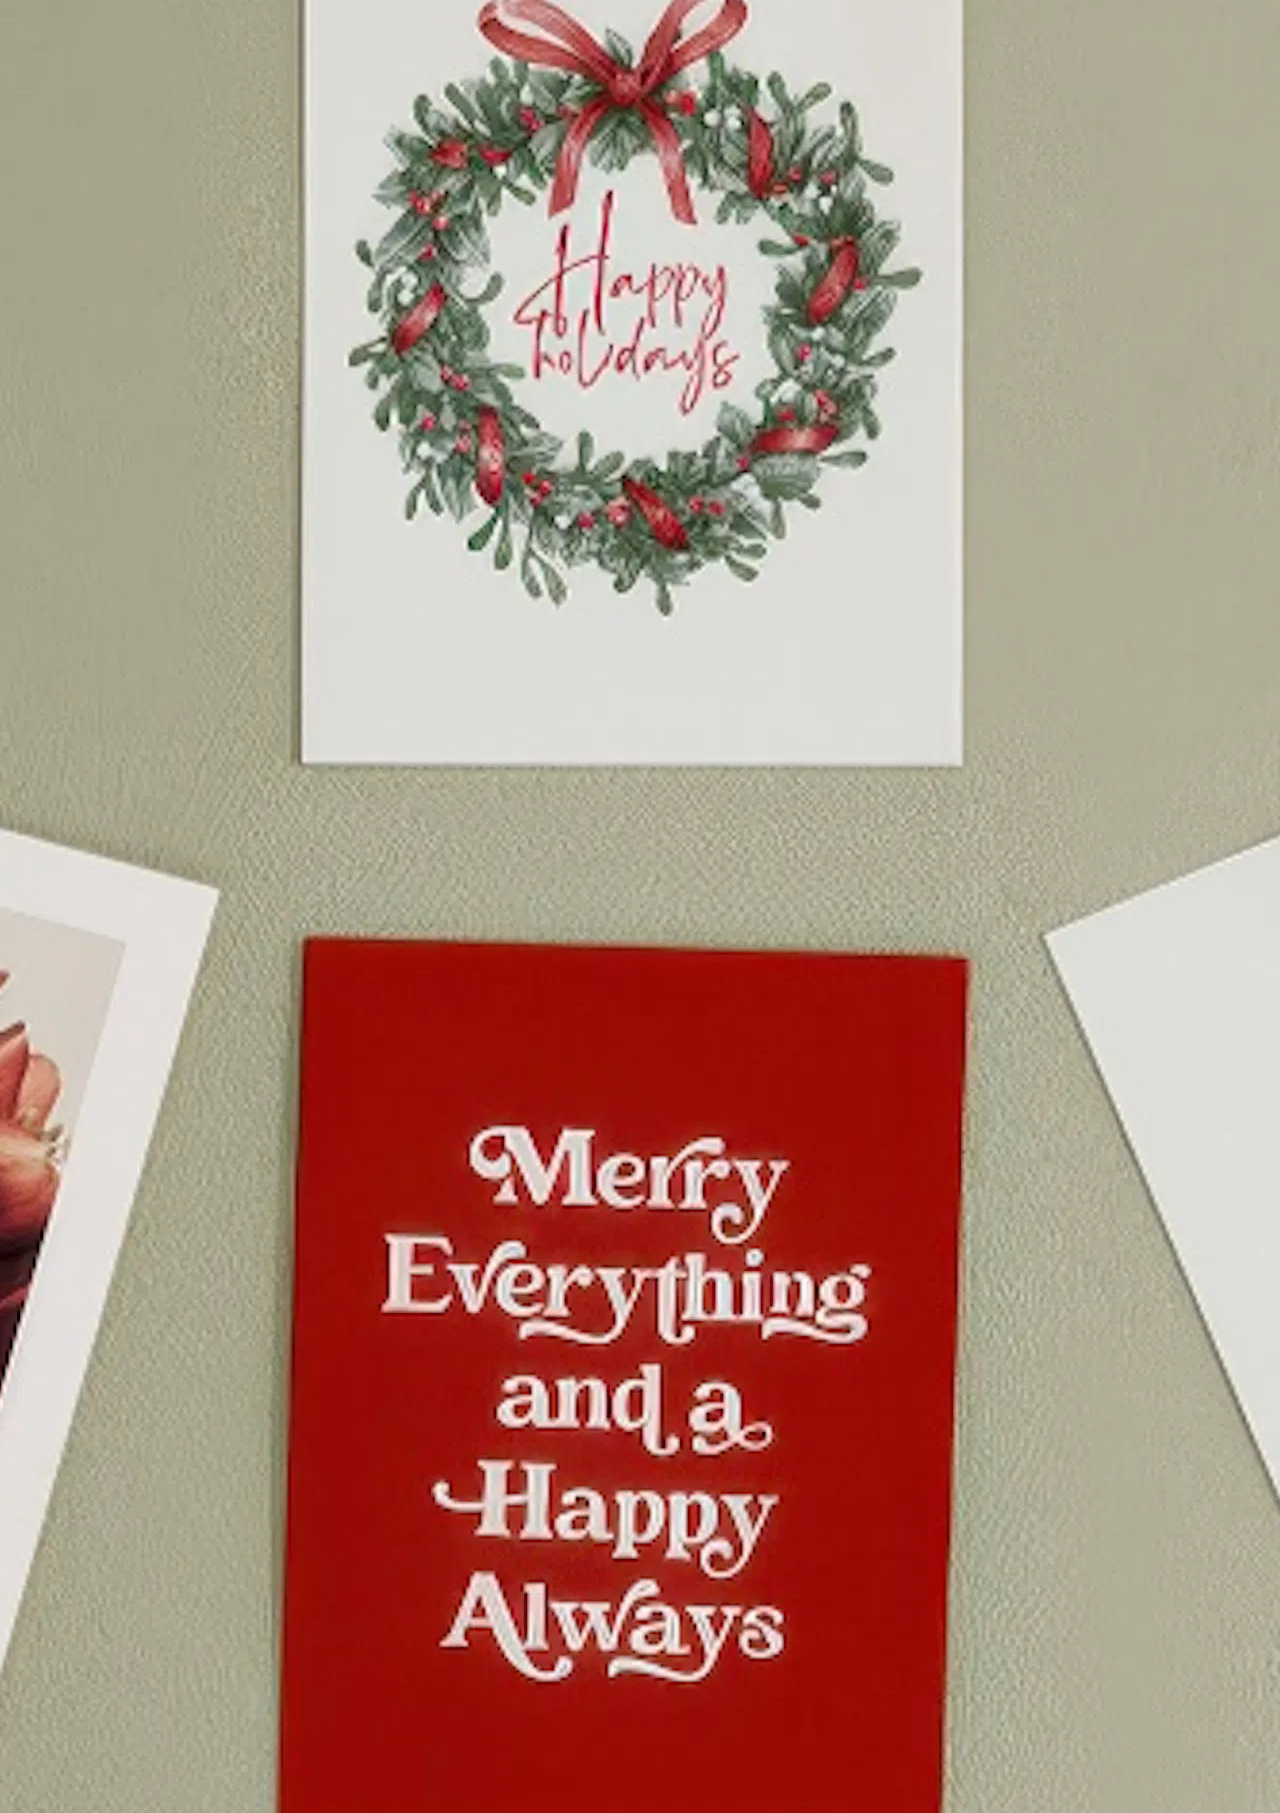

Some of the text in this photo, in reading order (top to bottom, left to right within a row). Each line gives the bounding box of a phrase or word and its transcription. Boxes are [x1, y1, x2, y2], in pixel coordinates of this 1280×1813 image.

[514, 190, 727, 340] Happy
[468, 1124, 792, 1246] Merry
[380, 1231, 873, 1347] Everything
[495, 1361, 775, 1458] and a
[430, 1458, 781, 1580] Happy
[438, 1569, 786, 1684] Always
